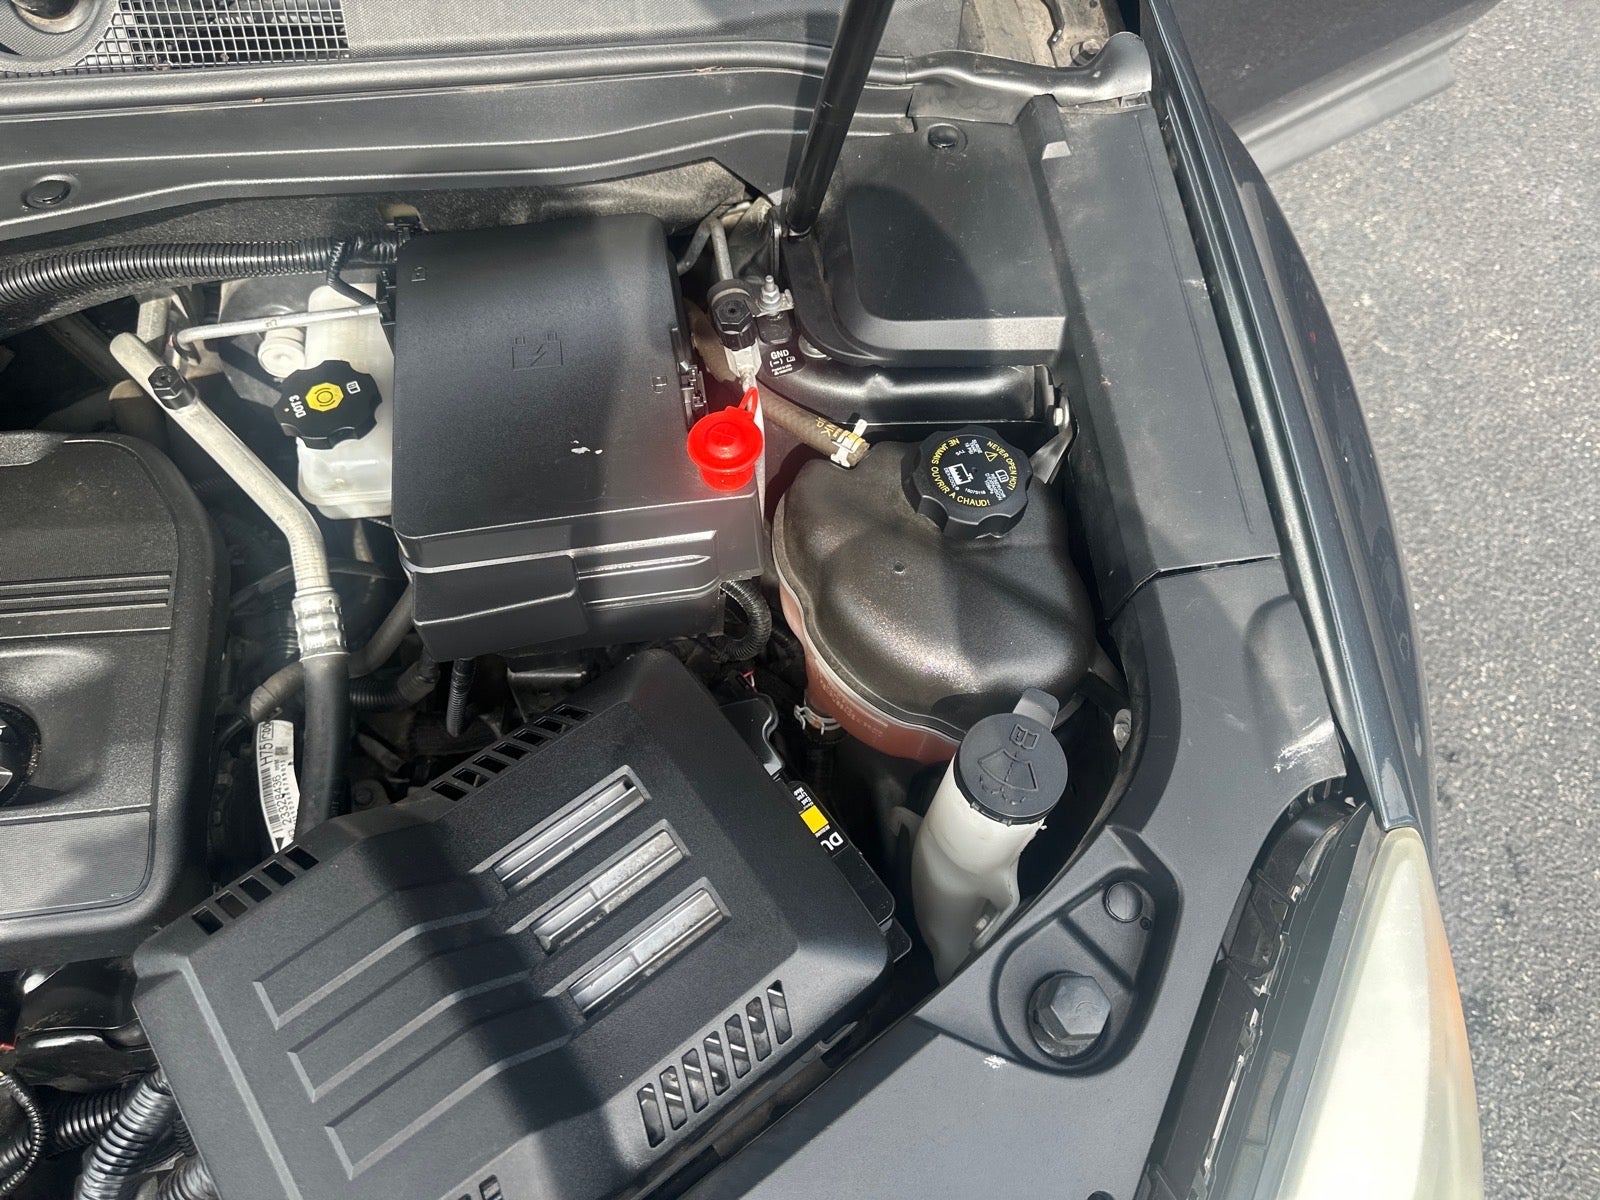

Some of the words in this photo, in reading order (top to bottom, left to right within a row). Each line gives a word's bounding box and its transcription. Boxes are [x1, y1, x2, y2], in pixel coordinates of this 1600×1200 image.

[770, 349, 789, 360] GND
[947, 438, 960, 448] NE
[986, 441, 1009, 459] NEVER
[931, 443, 949, 465] JAMAIS
[1005, 457, 1017, 476] OPEN
[931, 466, 950, 494] OUVRIR
[1006, 475, 1018, 491] HOT!
[956, 495, 991, 507] CHAUD!
[259, 742, 274, 767] H75
